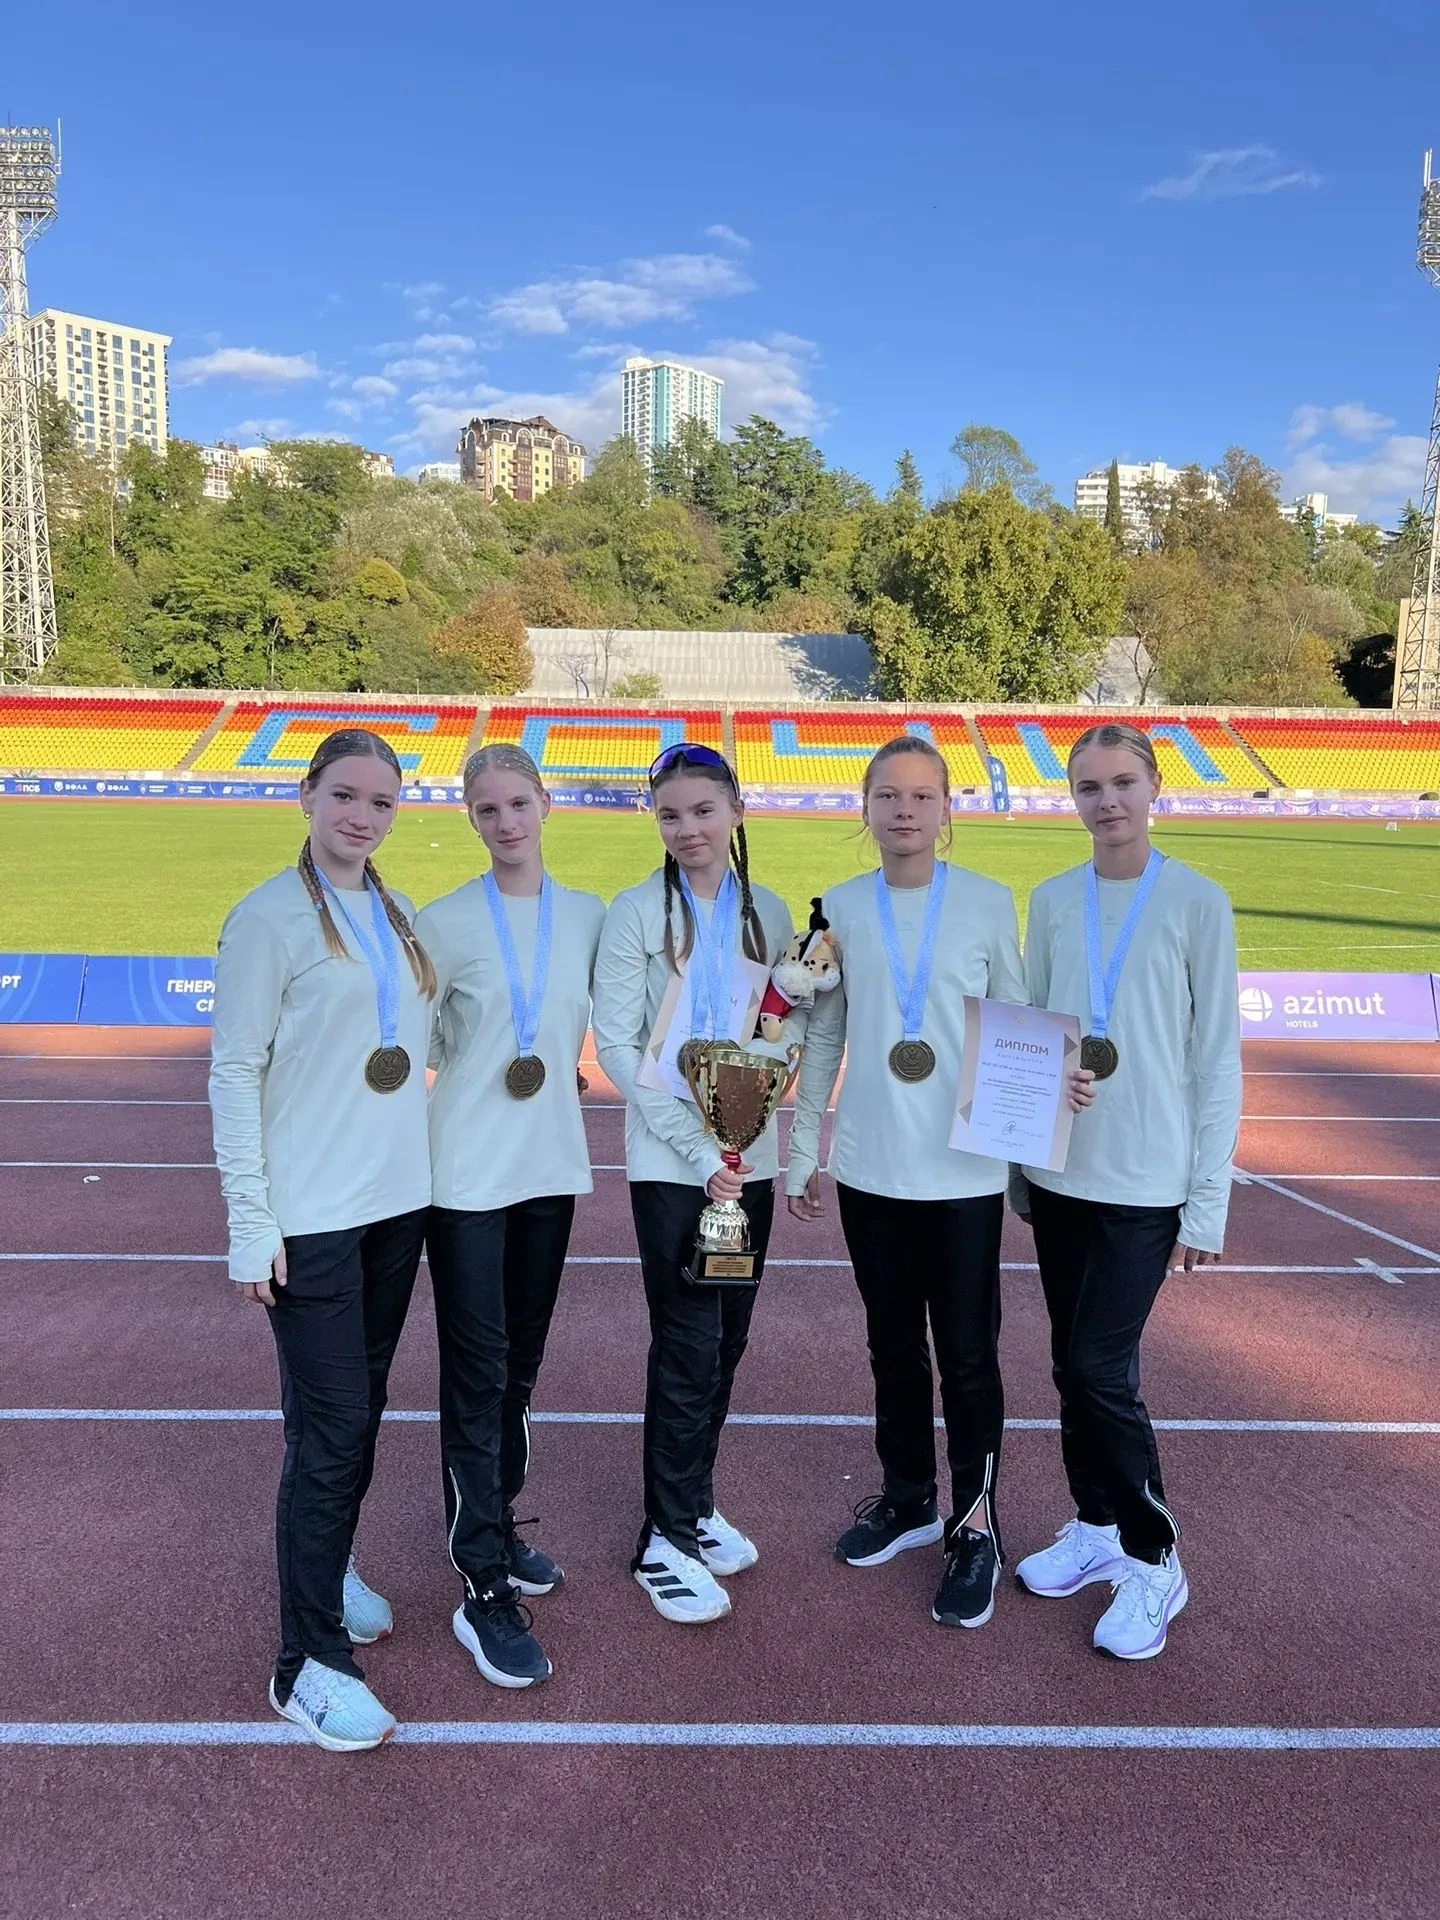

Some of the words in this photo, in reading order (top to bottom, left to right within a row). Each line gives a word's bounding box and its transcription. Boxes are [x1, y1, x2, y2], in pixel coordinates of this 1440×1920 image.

[0, 975, 22, 989] РТ
[1283, 989, 1386, 1016] azimut
[1285, 1020, 1319, 1029] HOTELS
[994, 1038, 1049, 1056] ДИПЛОМ
